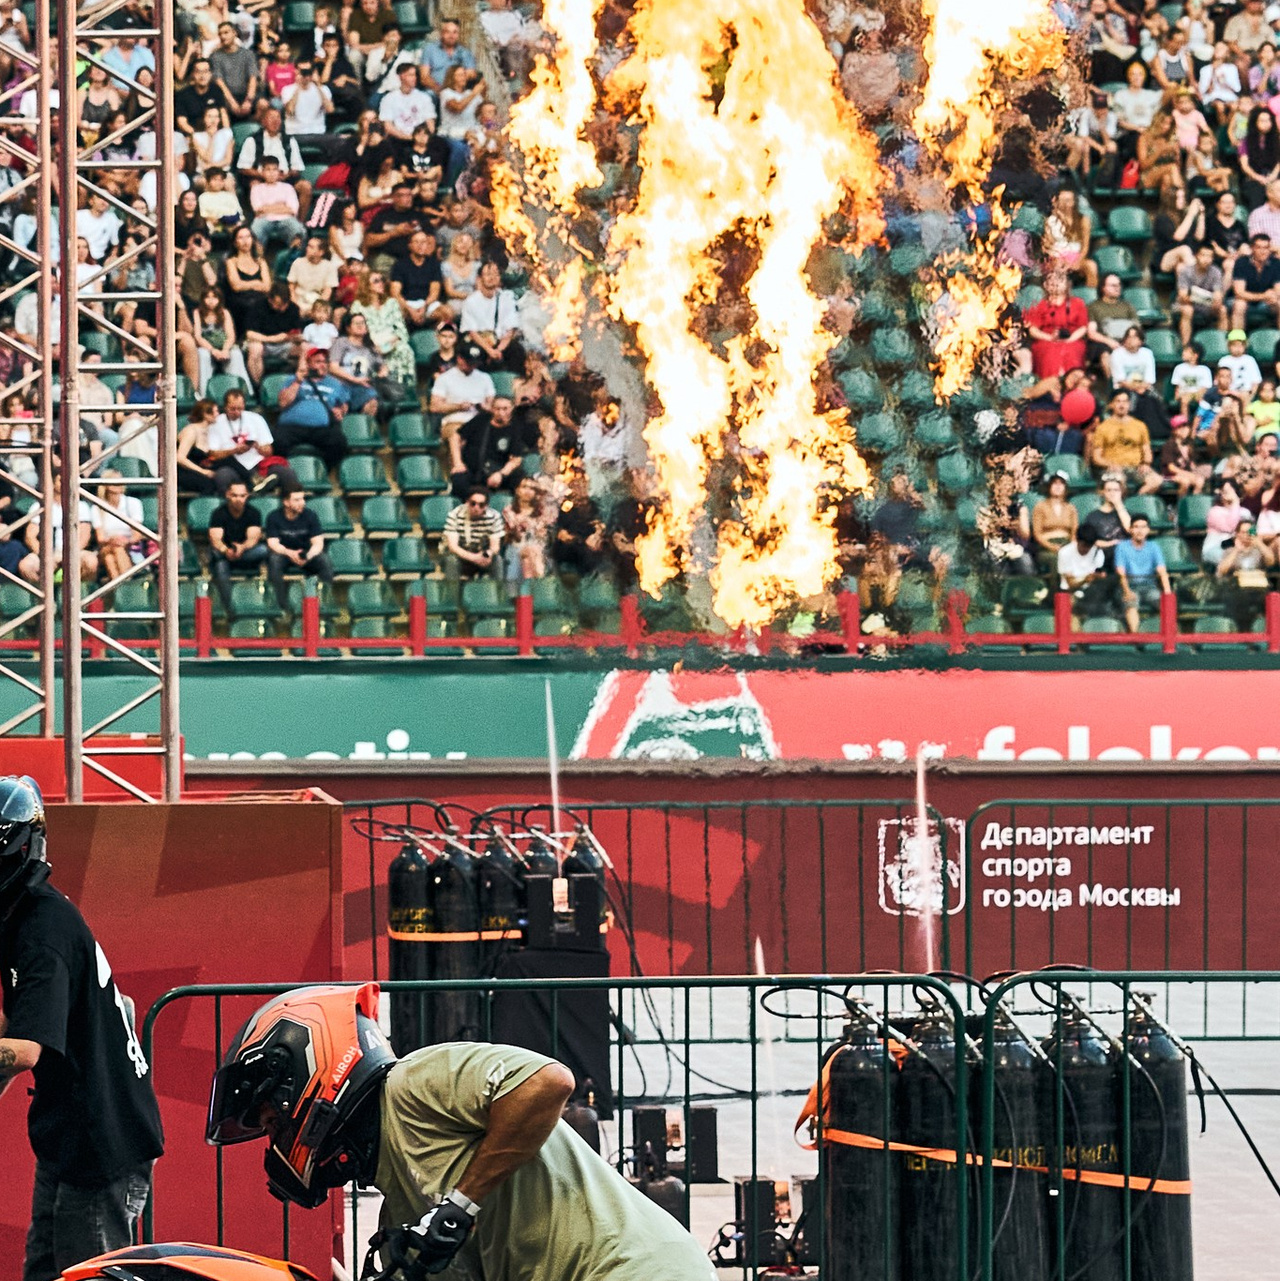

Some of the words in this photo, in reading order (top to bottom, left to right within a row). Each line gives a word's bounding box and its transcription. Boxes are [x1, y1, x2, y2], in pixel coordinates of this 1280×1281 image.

[980, 822, 1155, 851] Департамент
[981, 857, 1072, 882] спорта
[1078, 883, 1181, 907] Москвы
[331, 1045, 358, 1083] AIROH
